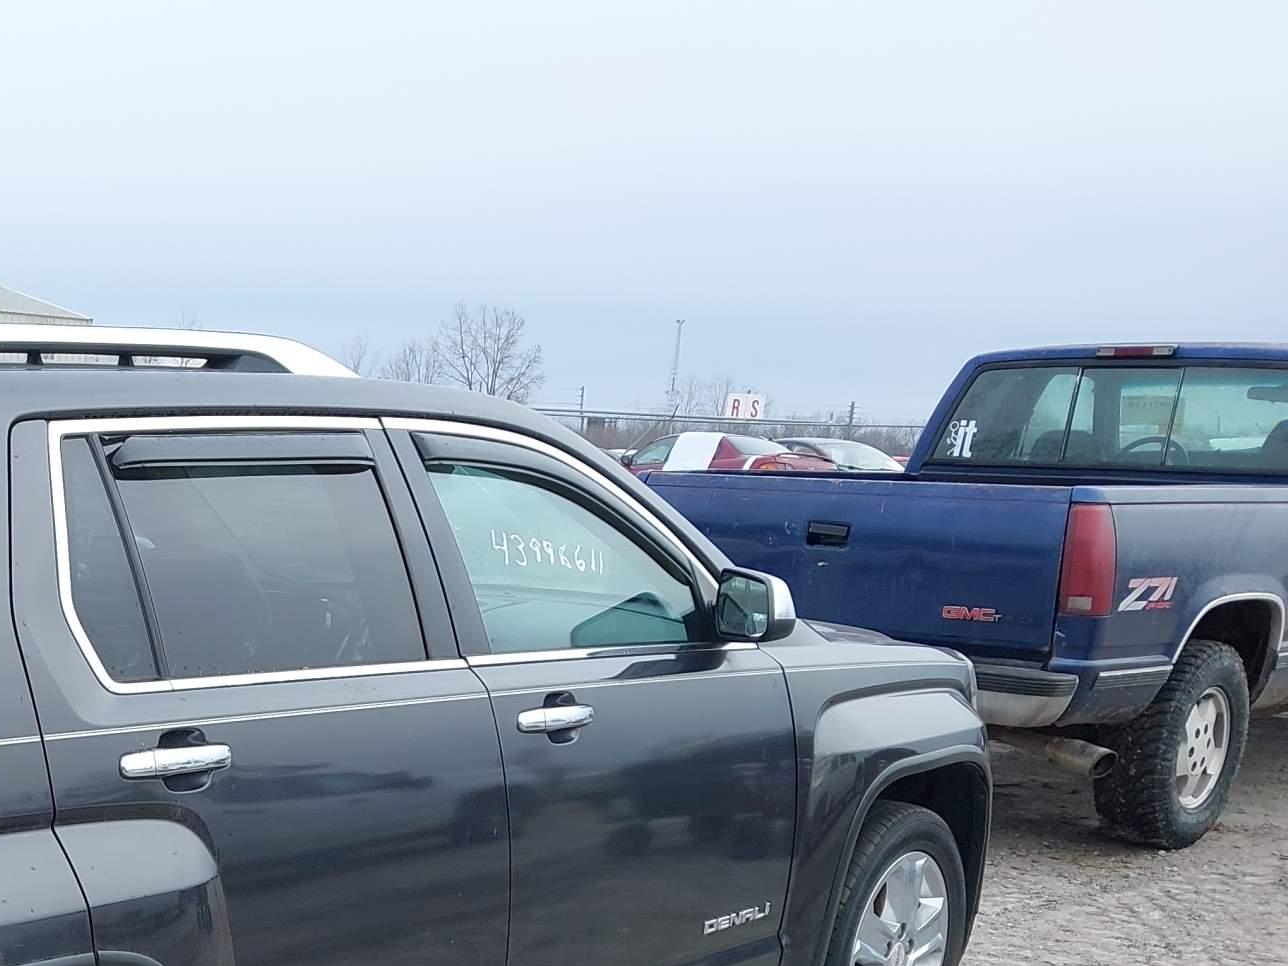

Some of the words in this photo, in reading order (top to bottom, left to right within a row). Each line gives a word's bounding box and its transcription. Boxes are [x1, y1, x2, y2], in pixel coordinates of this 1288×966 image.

[730, 398, 741, 417] R
[750, 399, 760, 418] S
[490, 529, 604, 575] 43996611
[1118, 576, 1178, 612] Z71
[703, 901, 771, 936] DENALI
